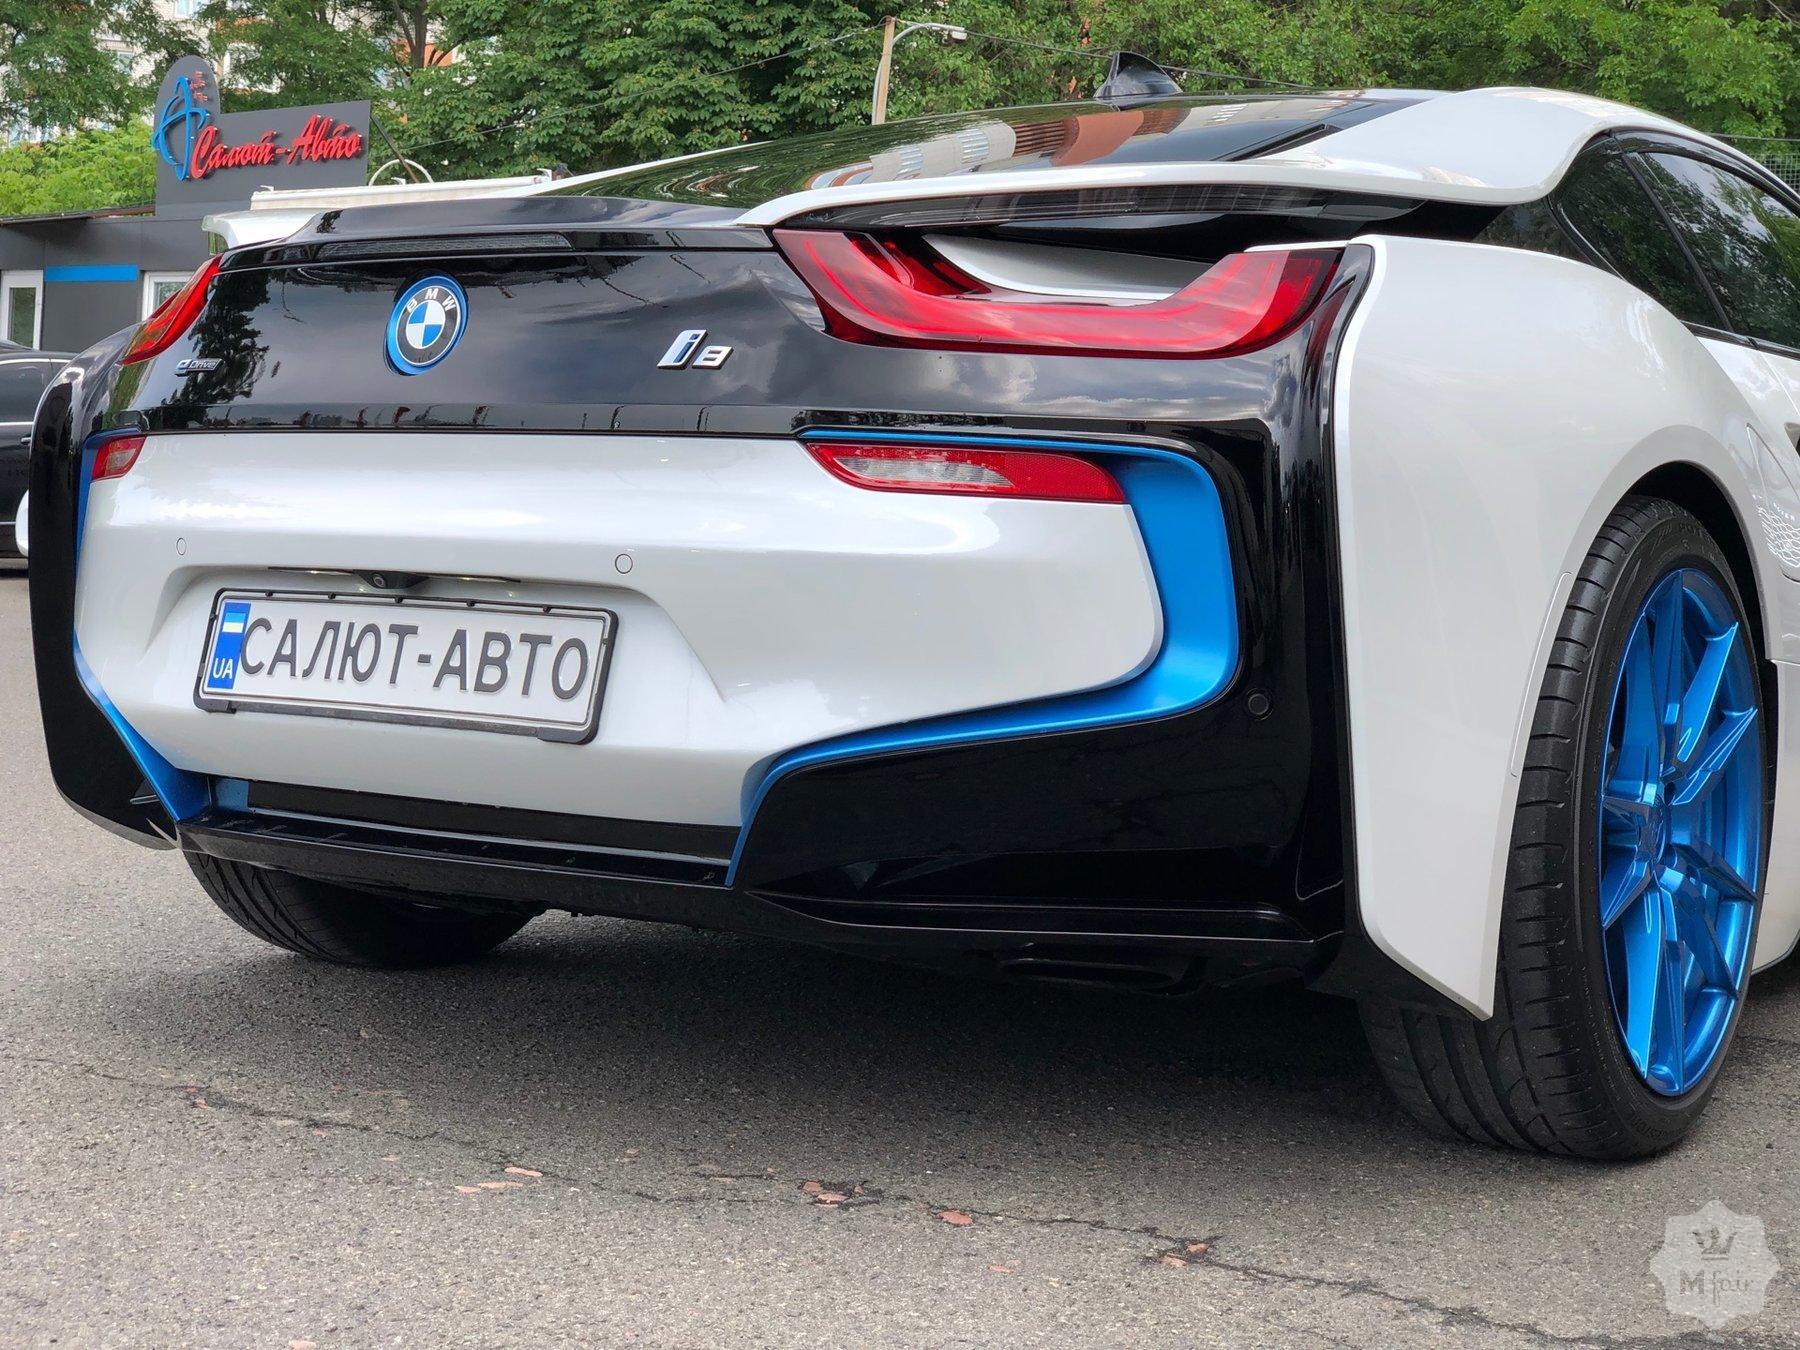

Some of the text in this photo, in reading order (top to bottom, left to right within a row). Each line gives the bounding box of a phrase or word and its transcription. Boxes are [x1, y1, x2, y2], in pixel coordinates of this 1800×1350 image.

[406, 288, 457, 313] BMW
[657, 329, 734, 370] i8
[212, 656, 234, 681] UA
[240, 617, 589, 701] САЛЮТ-АВТО
